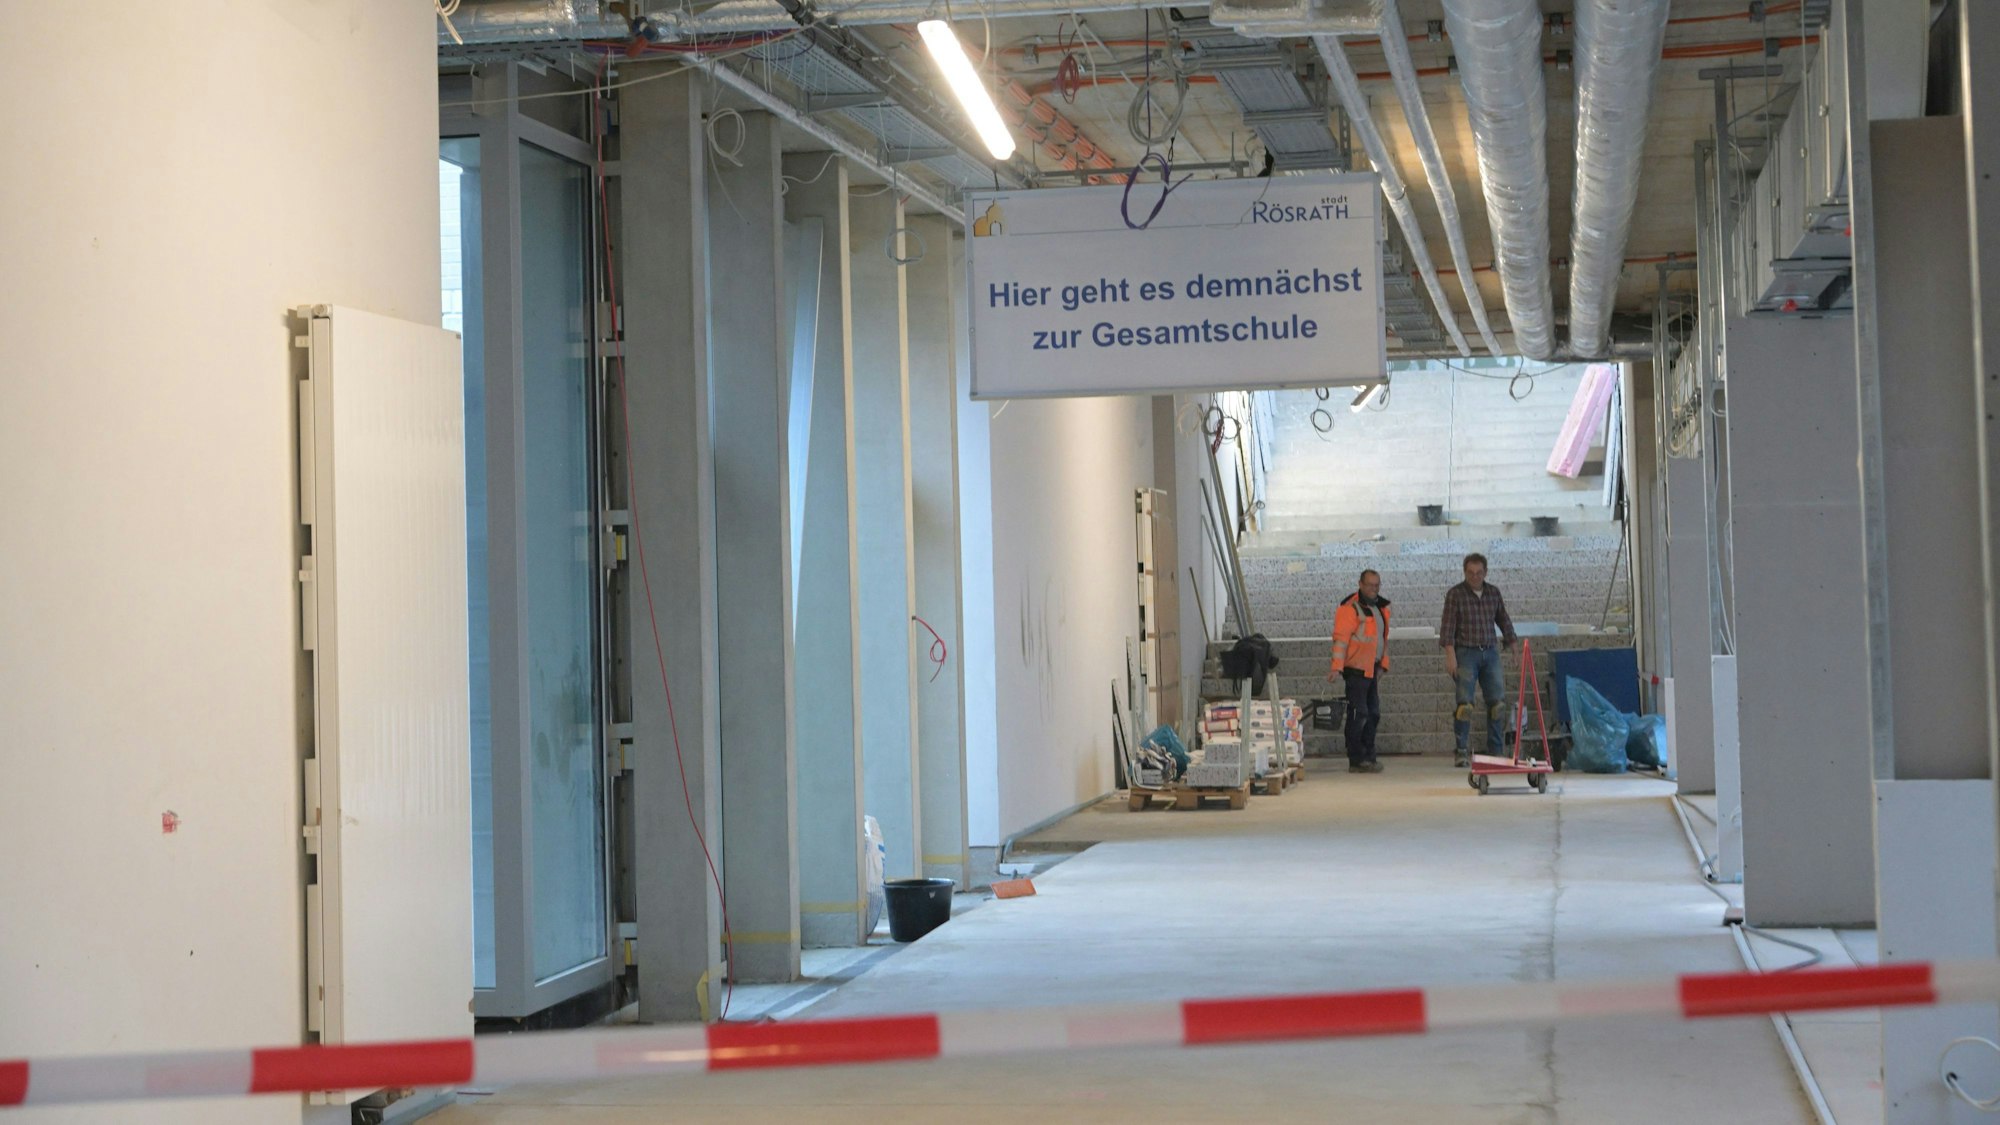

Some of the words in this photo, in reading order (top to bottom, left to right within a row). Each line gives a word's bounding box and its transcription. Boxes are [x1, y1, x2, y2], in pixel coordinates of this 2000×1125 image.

[1252, 201, 1349, 224] RÖSRATH
[1320, 194, 1348, 205] stadt
[989, 282, 1052, 308] Hier
[1061, 277, 1131, 312] geht
[1139, 280, 1176, 301] es
[1186, 267, 1363, 299] demnächst
[1032, 328, 1083, 350] zur
[1092, 313, 1319, 348] Gesamtschule
